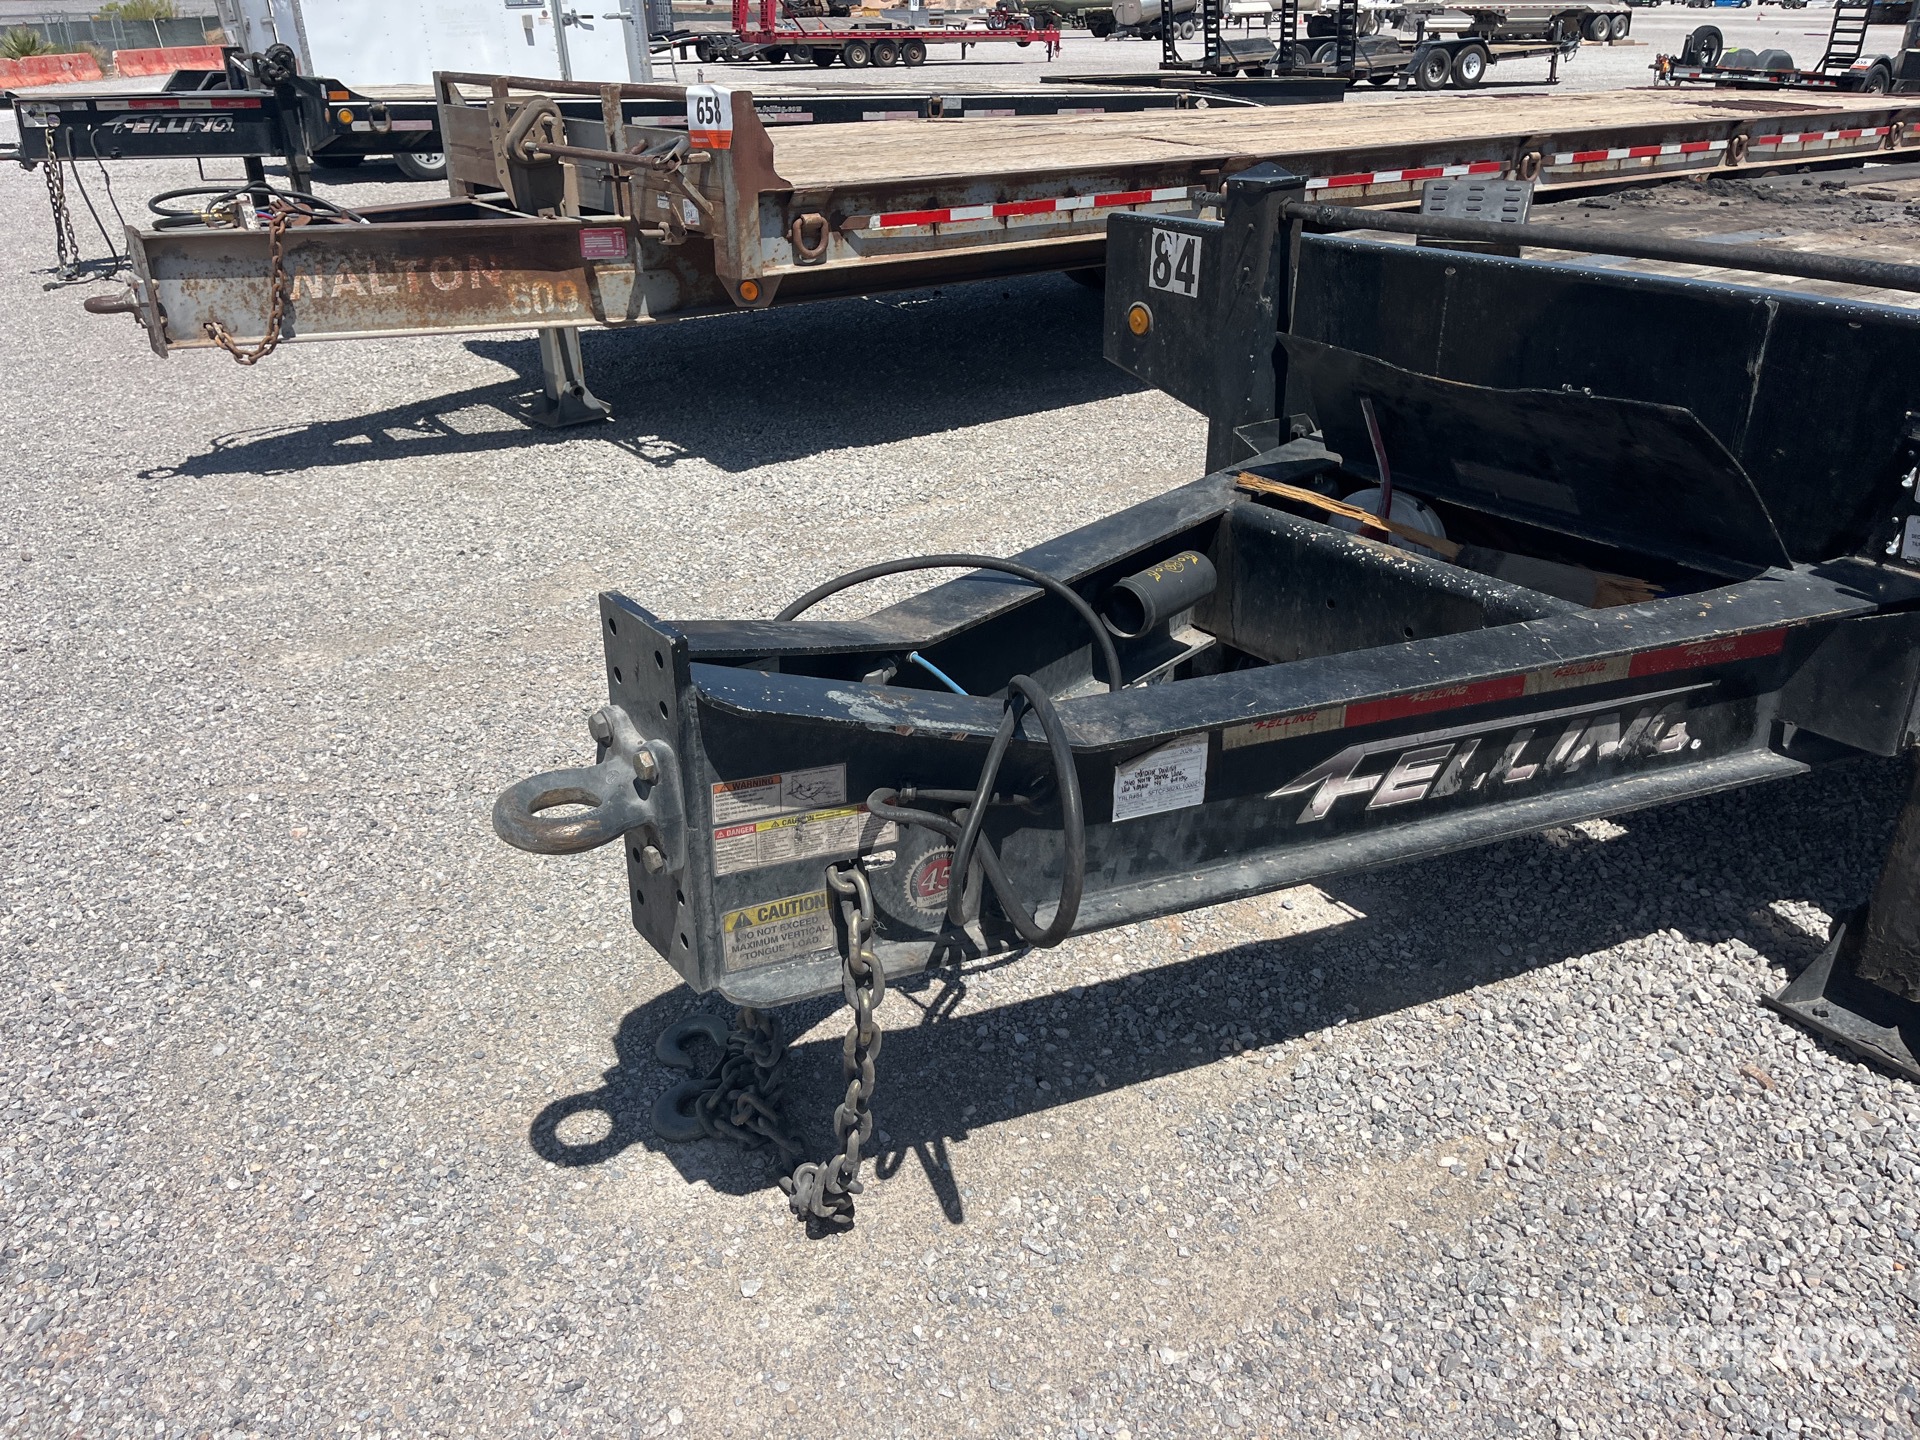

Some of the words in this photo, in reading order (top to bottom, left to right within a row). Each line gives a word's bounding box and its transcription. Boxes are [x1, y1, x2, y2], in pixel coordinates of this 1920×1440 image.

[696, 96, 722, 125] 658
[1153, 232, 1195, 294] 84
[1553, 661, 1607, 678] FELLING
[1409, 685, 1468, 702] FELLING
[1254, 711, 1317, 730] FELLING
[732, 776, 774, 790] WARNING
[726, 826, 755, 837] DANGER
[921, 866, 951, 891] 45
[757, 894, 825, 922] CAUTION
[757, 925, 777, 937] NOT
[780, 916, 818, 931] EXCEED
[732, 936, 779, 953] MAXIMUM
[781, 925, 828, 941] VERTICAL
[793, 936, 821, 949] LOAD.
